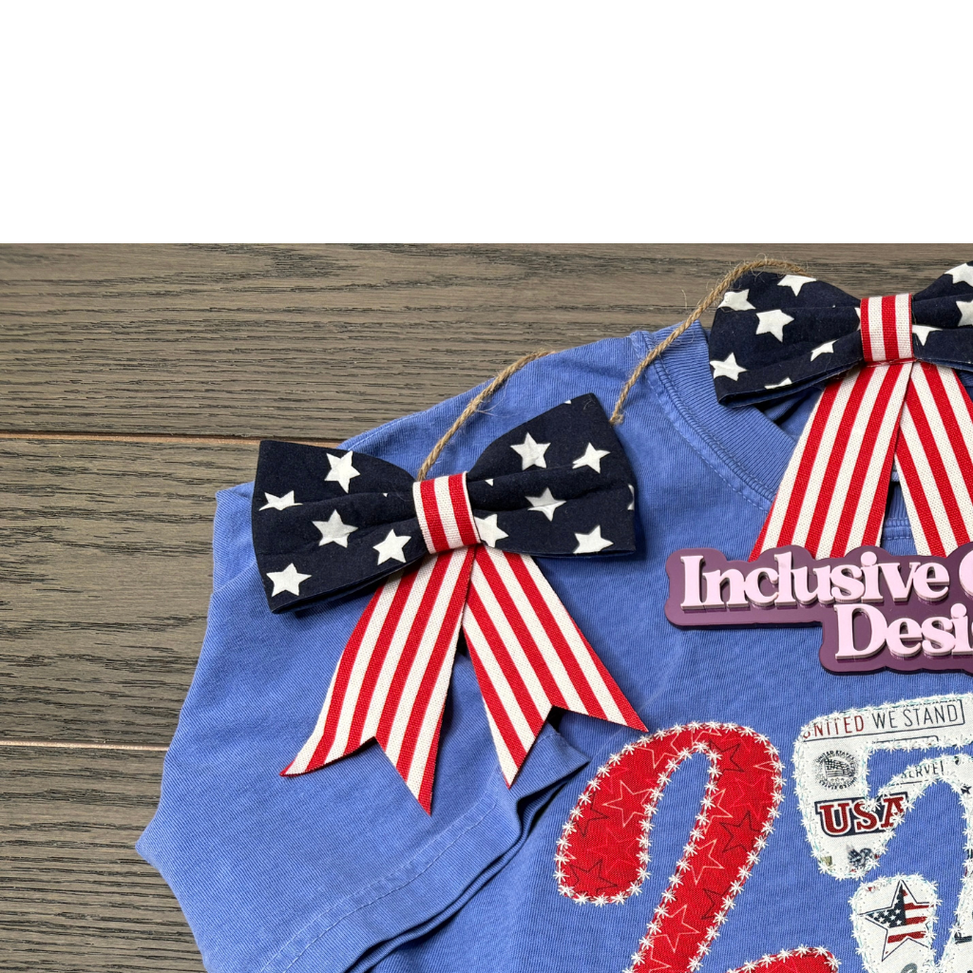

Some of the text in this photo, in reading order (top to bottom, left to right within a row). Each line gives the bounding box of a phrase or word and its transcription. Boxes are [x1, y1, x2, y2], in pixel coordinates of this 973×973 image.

[680, 551, 950, 611] Inclusive
[872, 711, 898, 729] WE
[902, 704, 958, 727] STAND
[818, 795, 905, 834] USA
